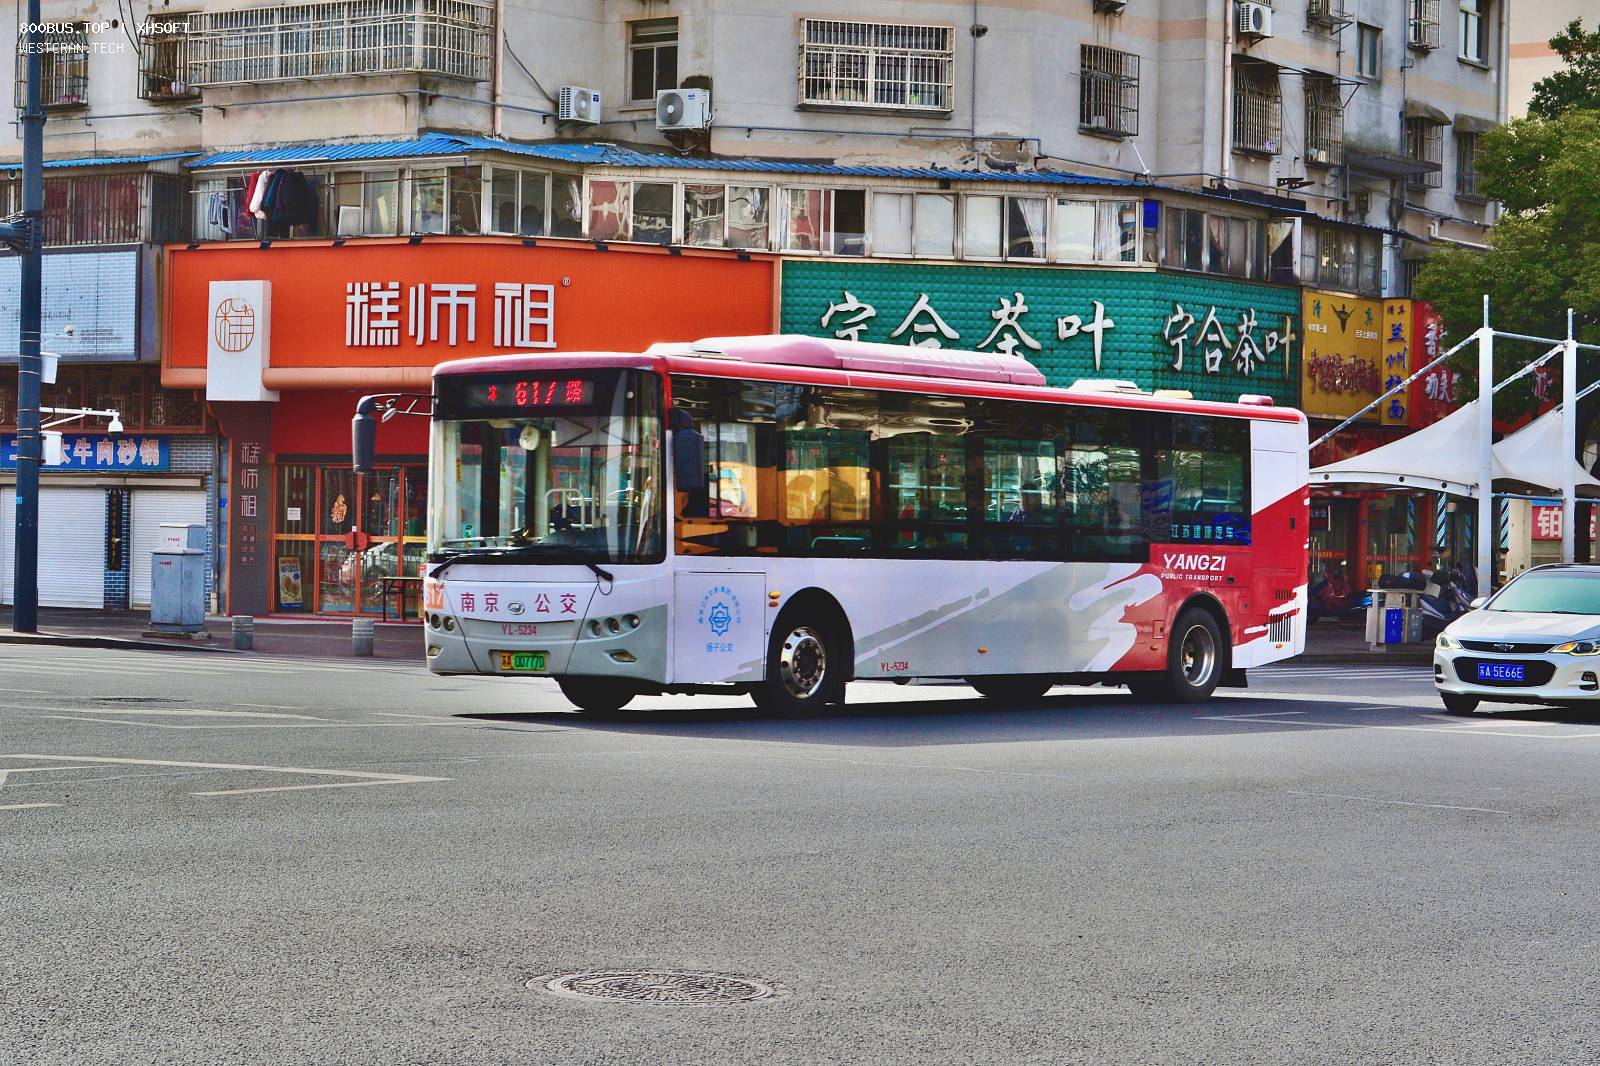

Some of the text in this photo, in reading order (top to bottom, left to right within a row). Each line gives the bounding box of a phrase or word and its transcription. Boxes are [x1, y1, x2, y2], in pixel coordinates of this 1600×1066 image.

[345, 281, 558, 349] 糕师祖
[820, 289, 1116, 373] 宁合茶叶
[1163, 303, 1297, 381] 宁合茶叶
[1385, 322, 1409, 419] 兰州拉面
[240, 442, 261, 517] 糕师祖
[1163, 553, 1226, 572] YANGZI
[1185, 574, 1223, 582] TRANSPORT
[460, 592, 577, 615] 南京 公交
[501, 624, 537, 636] YL-5234
[880, 661, 909, 672] YL-5234
[1493, 666, 1524, 679] 5E66E
